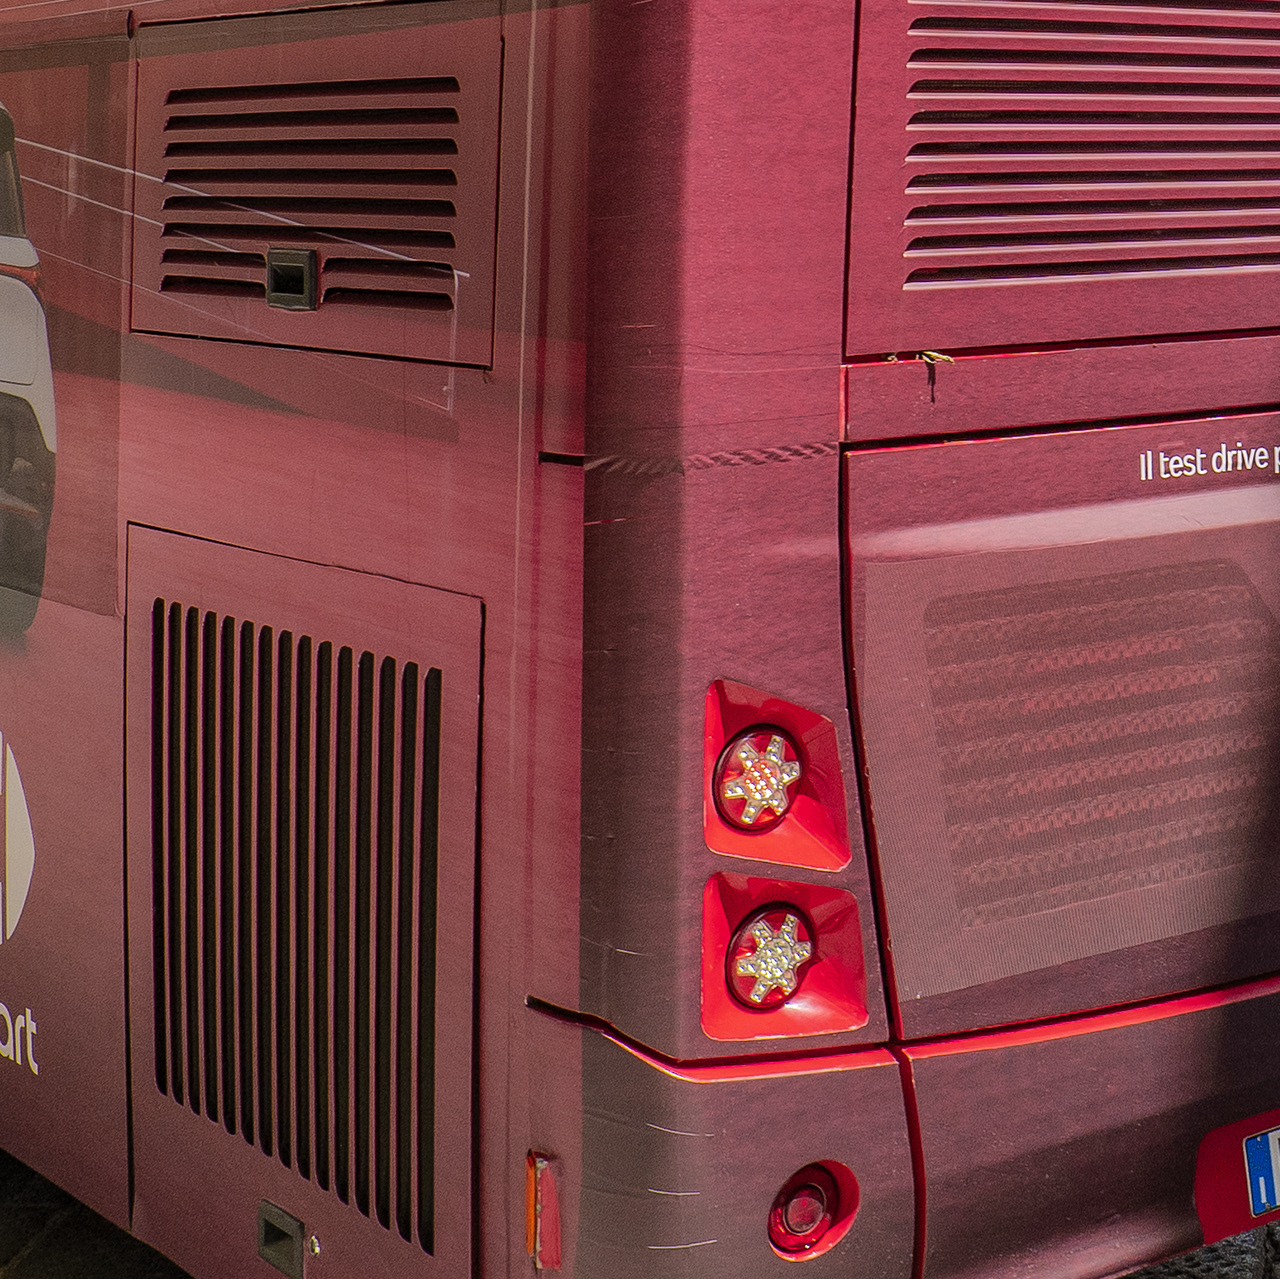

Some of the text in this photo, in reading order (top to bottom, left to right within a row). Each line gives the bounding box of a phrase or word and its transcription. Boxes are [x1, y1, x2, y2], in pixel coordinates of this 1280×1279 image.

[1139, 450, 1153, 481] Il
[1159, 447, 1207, 478] test
[1211, 442, 1270, 474] drive
